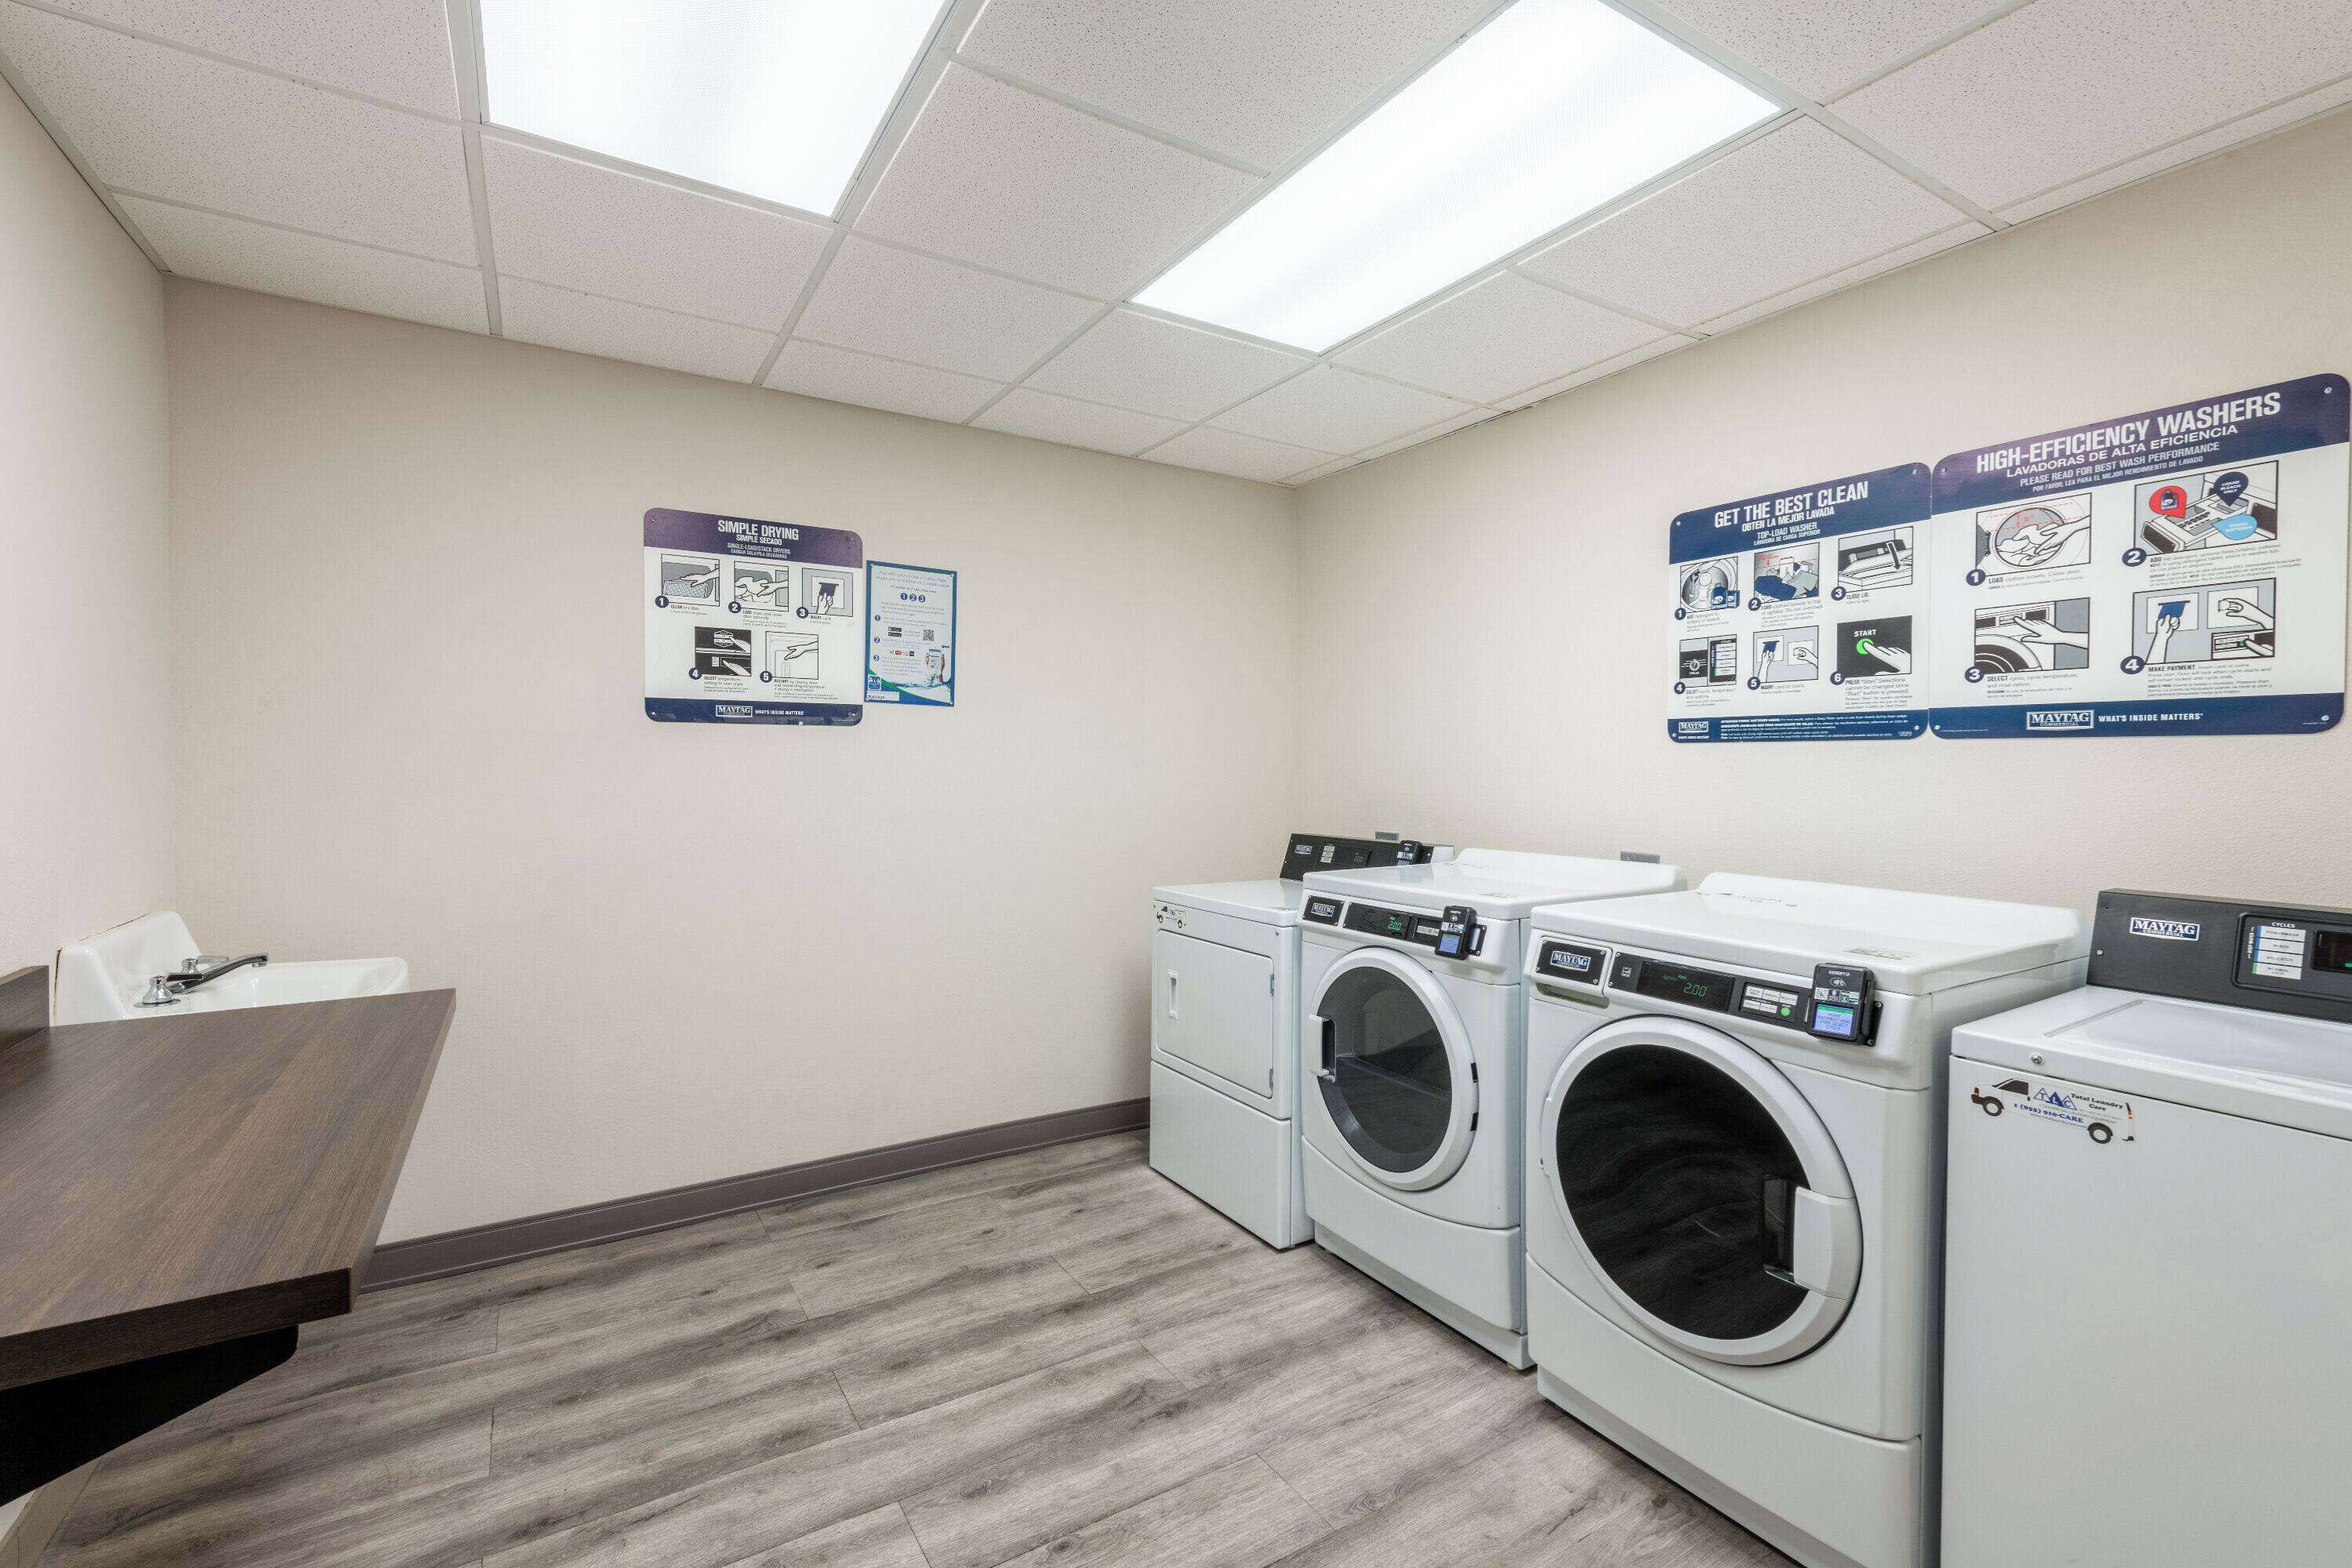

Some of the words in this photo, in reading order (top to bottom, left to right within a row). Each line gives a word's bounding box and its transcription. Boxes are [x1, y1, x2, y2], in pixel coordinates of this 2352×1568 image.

[1976, 419, 2150, 474] HIGH-EFFICIENCY
[2158, 392, 2281, 437] WASHERS
[2006, 454, 2085, 477] LAVADORAS
[2089, 449, 2107, 461] DE
[2111, 443, 2146, 457] ALTA
[2151, 424, 2238, 450] EFICIENCIA
[2020, 474, 2049, 487] PLEASE
[2052, 470, 2074, 481] READ
[2075, 466, 2092, 476] FOR
[2095, 461, 2117, 473] BEST
[2119, 456, 2145, 468] WASH
[2148, 442, 2220, 463] PERFORMANCE
[2102, 470, 2123, 480] MEJOR
[2124, 463, 2167, 476] RENDIMIENTO
[2178, 456, 2203, 466] LAVADO
[1715, 508, 1740, 528] GET
[1744, 502, 1770, 522] THE
[1775, 492, 1813, 515] BEST
[1818, 481, 1869, 506] CLEAN
[1742, 521, 1765, 532] OBTEN
[1767, 518, 1776, 527] LA
[1778, 511, 1804, 525] MEJOR
[1806, 506, 1835, 519] LAVADA
[717, 519, 758, 536] SIMPLE
[761, 524, 799, 541] DRYING
[1757, 528, 1788, 539] TOP-LOAD
[1790, 521, 1817, 534] WASHER
[1783, 533, 1798, 542] CARGA
[1798, 529, 1820, 539] SUPERIOR
[736, 534, 758, 543] SIMPLE
[760, 536, 782, 546] SECADO
[2128, 550, 2140, 564] 2
[1971, 572, 1979, 583] 1
[1835, 590, 1842, 598] 3
[731, 603, 738, 612] 2
[1751, 600, 1758, 609] 2
[2125, 659, 2140, 671] 4
[1835, 673, 1841, 682] 6
[1969, 667, 1980, 681] 3
[1751, 679, 1756, 688] 5
[2031, 712, 2090, 724] MAYTAG
[2098, 714, 2127, 723] WHAT'S
[2129, 713, 2158, 722] INSIDE
[1680, 721, 1708, 730] MAYTAG
[2134, 920, 2195, 935] MAYTAG
[1553, 953, 1588, 966] MAYTAG
[2071, 1093, 2089, 1102] Total
[2091, 1098, 2123, 1109] Laundry
[2043, 1110, 2084, 1123] 910-CARE
